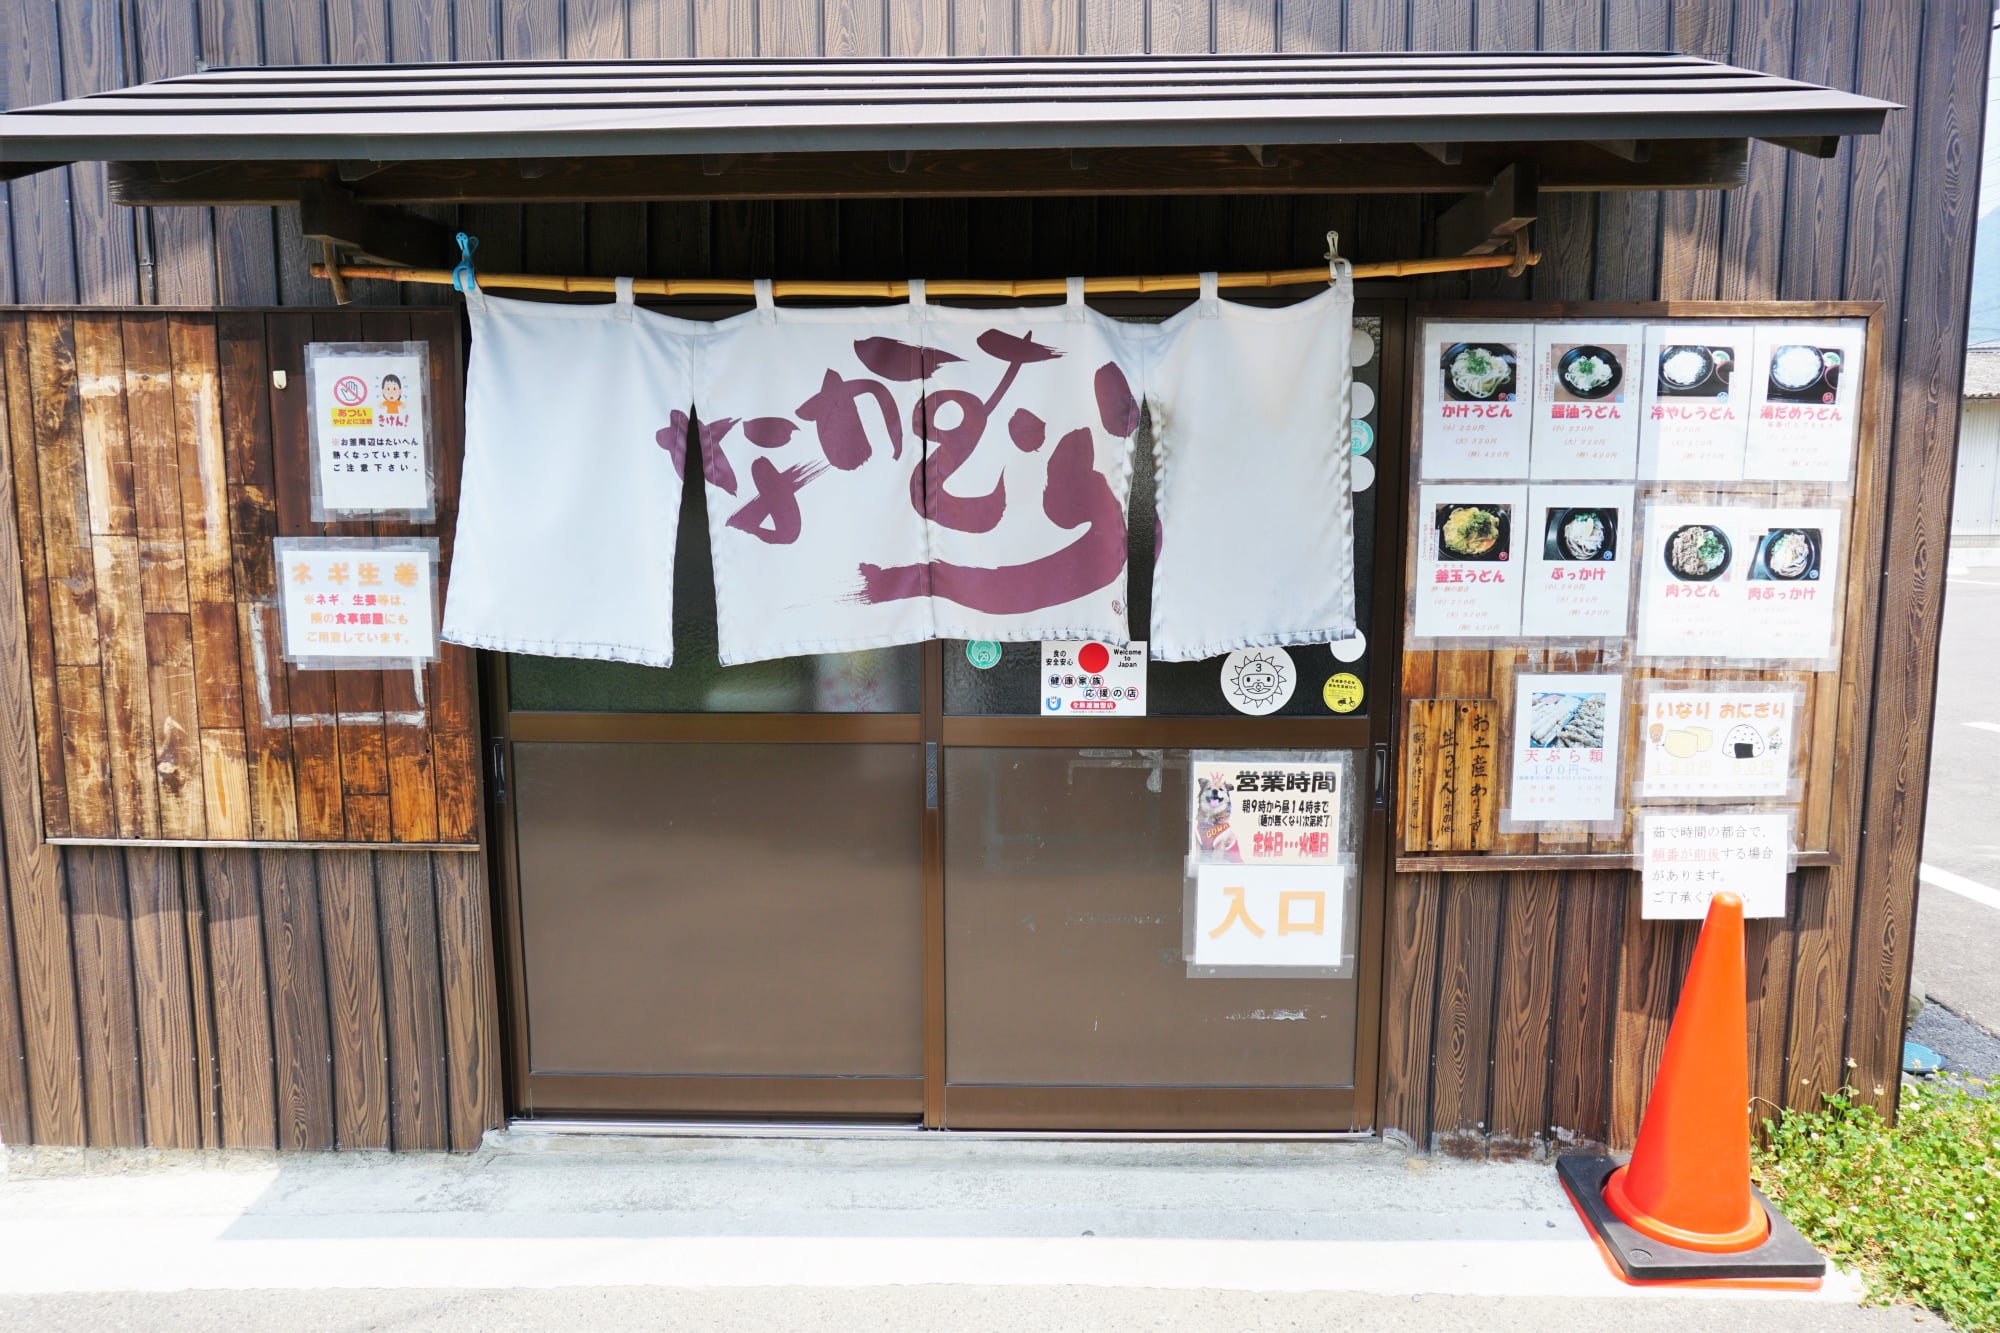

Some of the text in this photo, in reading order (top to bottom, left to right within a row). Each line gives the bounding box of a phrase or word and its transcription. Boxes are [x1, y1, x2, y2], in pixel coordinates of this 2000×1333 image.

[338, 409, 367, 417] あつい
[1442, 404, 1512, 418] かけうどん
[1552, 405, 1621, 419] 醤油うどん
[1650, 406, 1735, 420] 冷やしうどん
[1760, 405, 1842, 421] 湯だめうどん
[378, 414, 409, 427] きけん!
[333, 451, 417, 459] 熱くなっています。
[333, 464, 418, 472] ご注意下さい。
[291, 562, 419, 587] ネギ生姜
[1435, 569, 1505, 583] 釜玉うどん
[1551, 568, 1606, 580] ぶっかけ
[1666, 584, 1720, 598] 肉うどん
[1748, 587, 1816, 600] 肉ぶっかけ
[306, 631, 410, 644] ご用意しています。
[1053, 649, 1066, 657] 食の
[1255, 663, 1262, 672] 3
[1050, 676, 1102, 686] 健康家族
[1085, 688, 1137, 698] 応援の店
[1656, 702, 1709, 719] いなり
[1720, 702, 1785, 718] おにぎり
[1469, 713, 1490, 832] お土産あります
[1236, 770, 1336, 793] 営業時間
[1242, 799, 1329, 814] 朝9時から昼14時まで
[1653, 825, 1766, 838] 茹で時間の都合で、
[1653, 869, 1724, 882] があります。
[1653, 891, 1751, 904] ご了承く。
[1208, 886, 1325, 939] 入口
